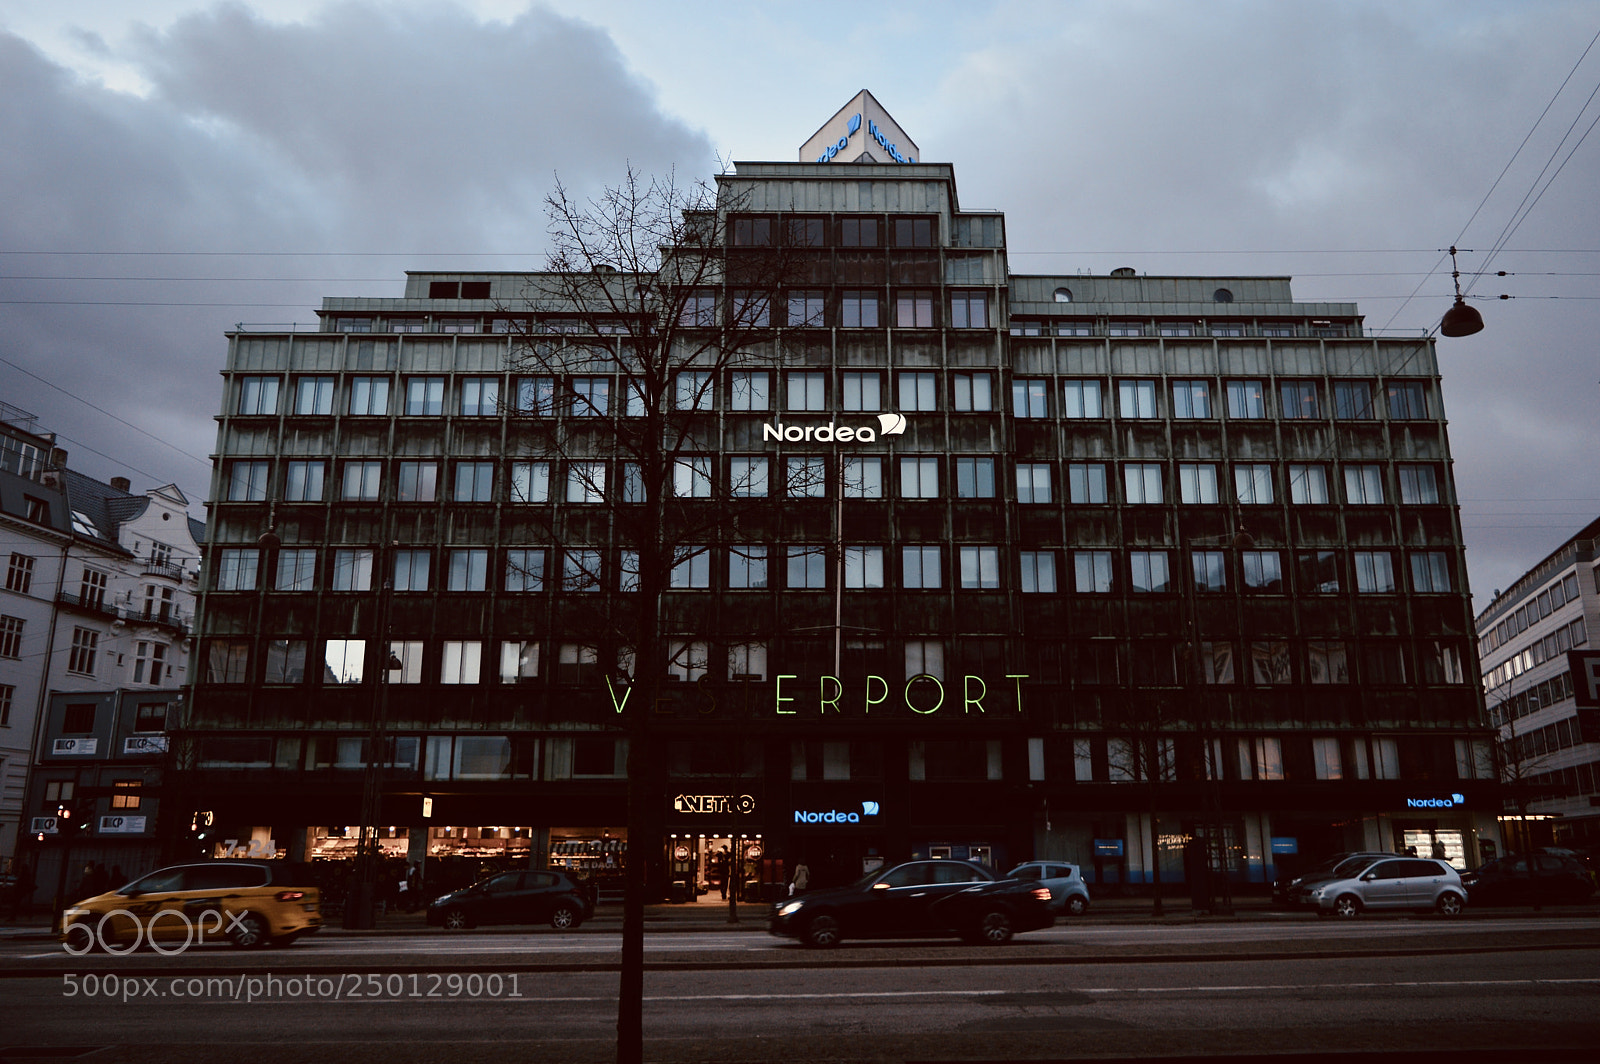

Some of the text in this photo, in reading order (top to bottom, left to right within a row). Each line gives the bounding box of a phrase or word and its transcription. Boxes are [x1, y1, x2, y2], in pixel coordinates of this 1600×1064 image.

[868, 119, 908, 163] Norde
[763, 422, 875, 443] Nordea
[65, 740, 76, 750] CP
[1407, 798, 1453, 808] Nordea
[794, 809, 860, 823] Nordea
[44, 818, 55, 829] CP
[112, 817, 124, 828] CP
[224, 839, 276, 857] 7-24
